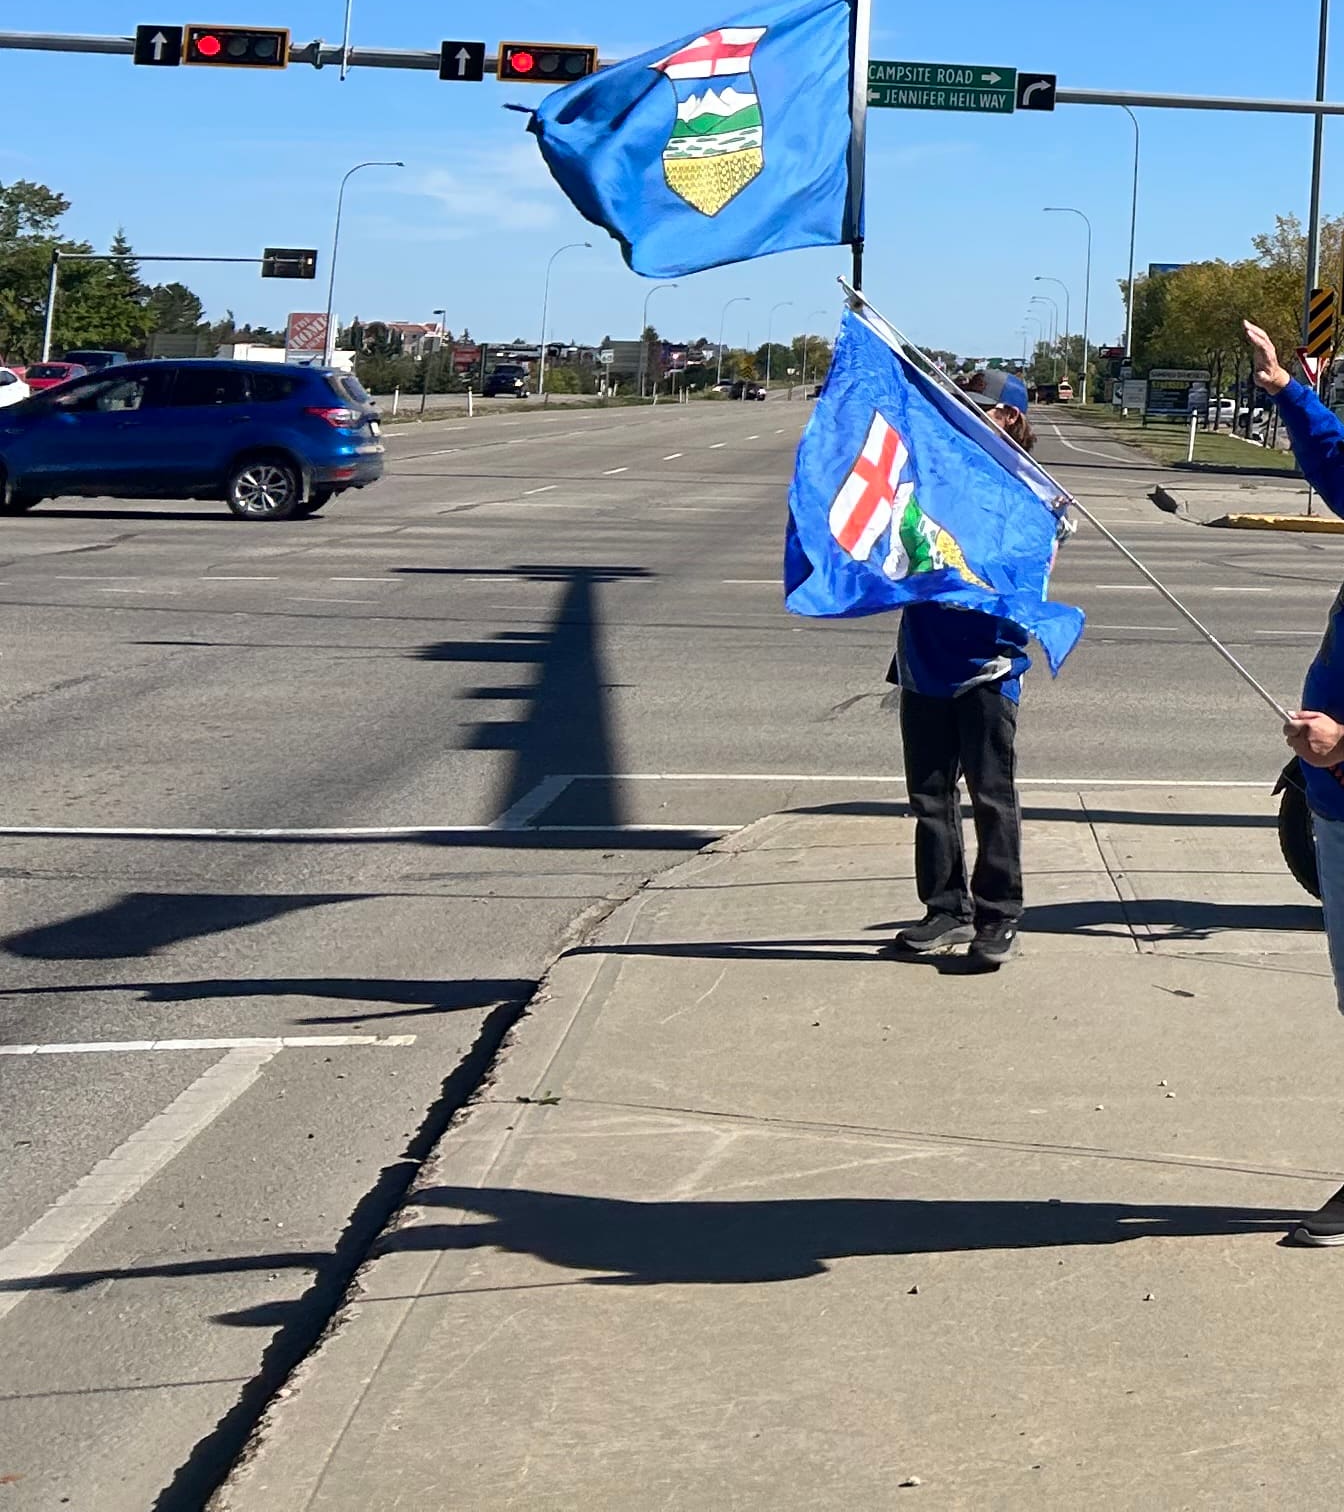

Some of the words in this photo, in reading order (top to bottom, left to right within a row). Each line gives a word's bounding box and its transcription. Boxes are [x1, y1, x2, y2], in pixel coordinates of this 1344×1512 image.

[868, 64, 931, 82] CAMPSITE
[936, 68, 974, 85] ROAD
[883, 89, 945, 106] JENNIFER
[949, 93, 976, 108] HEIL
[979, 94, 1006, 109] WAY
